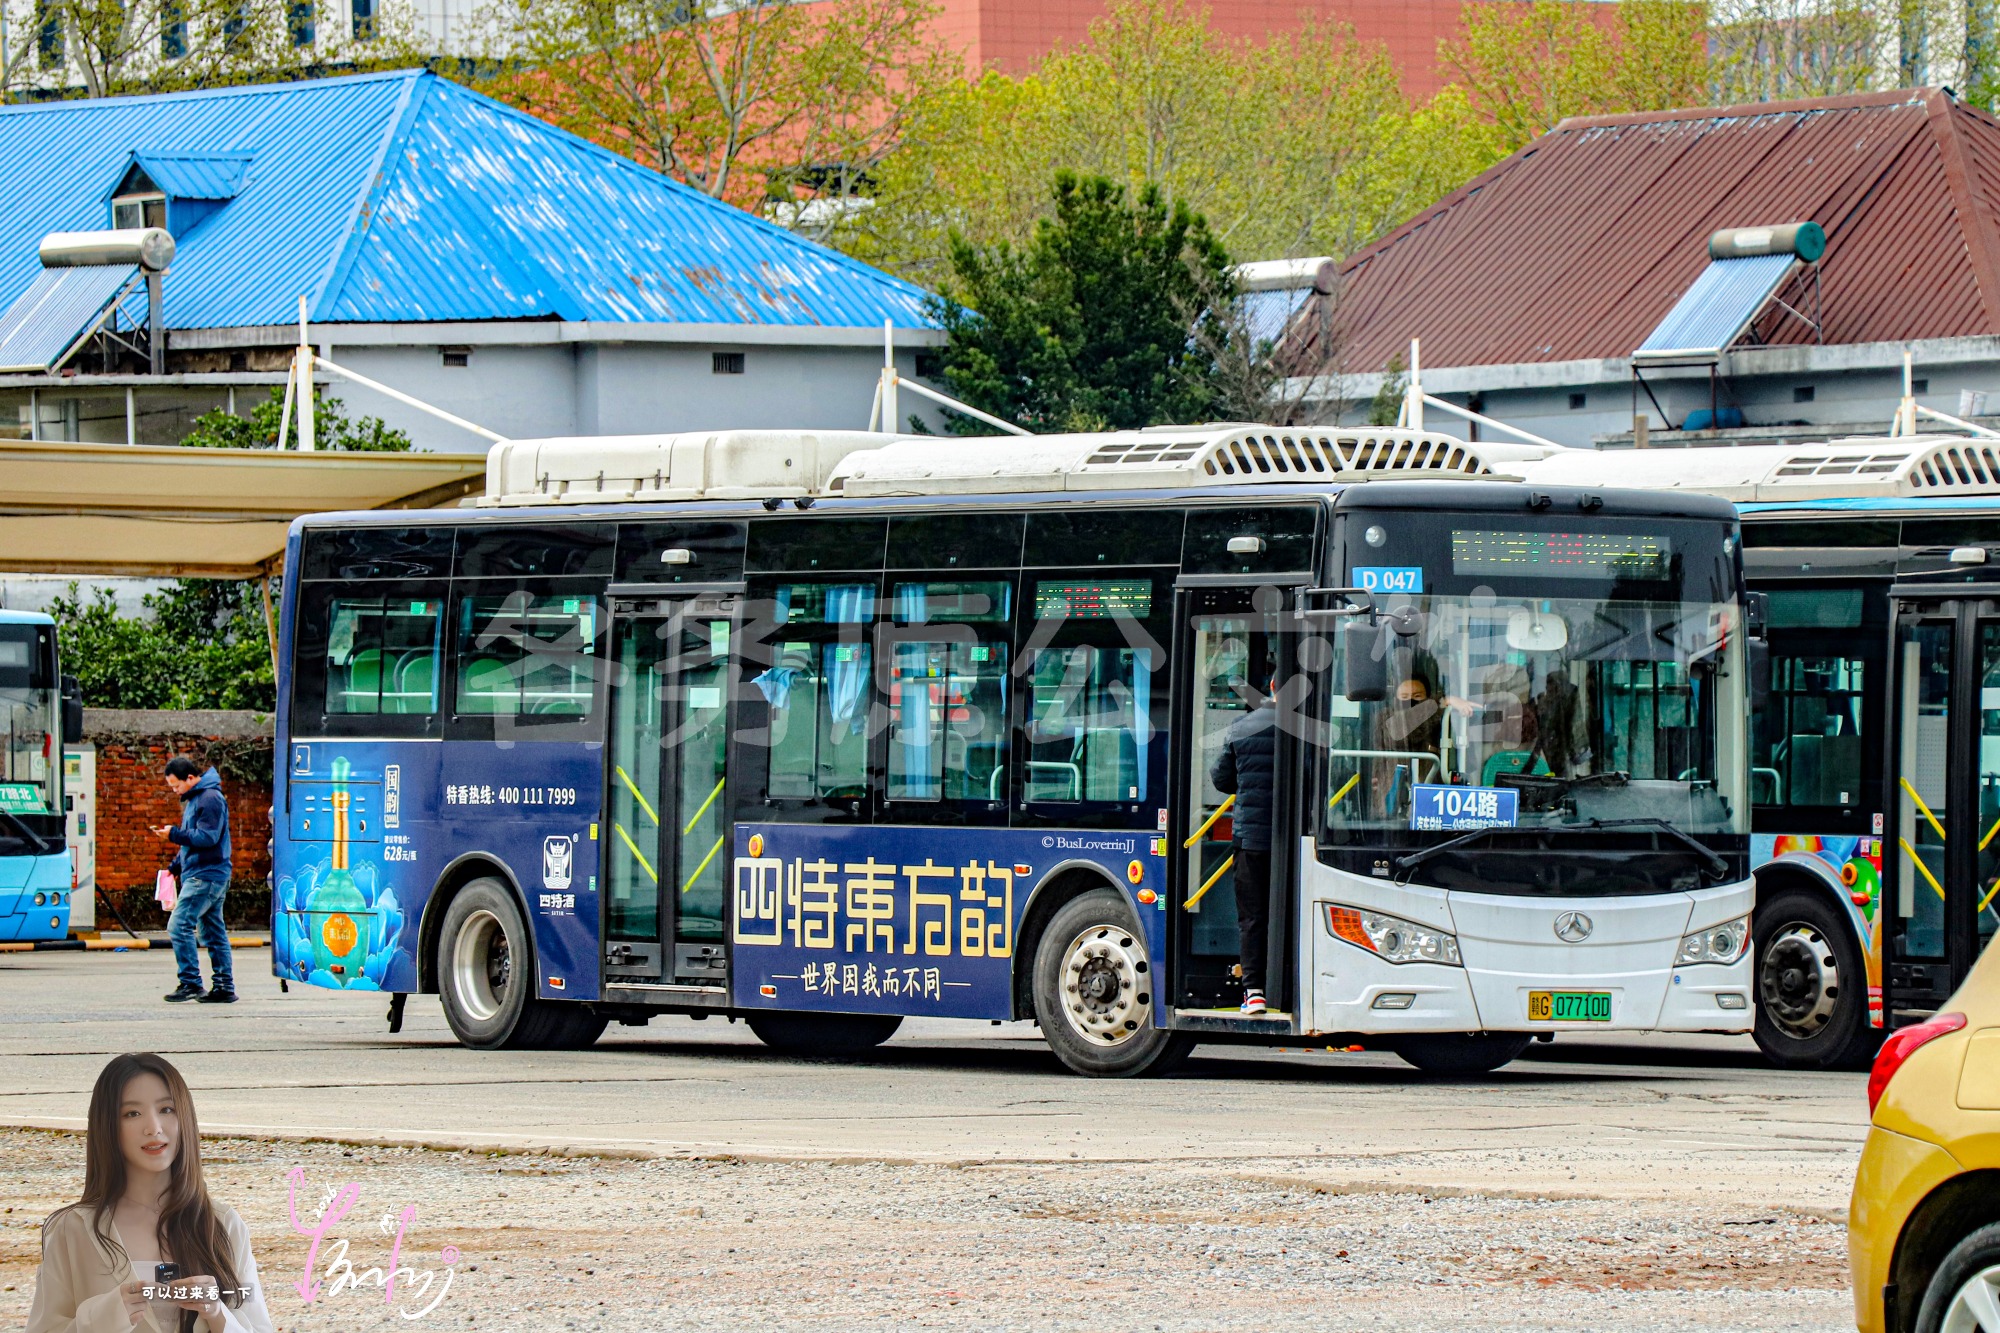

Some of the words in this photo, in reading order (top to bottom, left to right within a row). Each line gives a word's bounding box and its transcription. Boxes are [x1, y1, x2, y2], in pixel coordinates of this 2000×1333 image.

[1362, 570, 1378, 588] D
[1383, 570, 1416, 592] 047
[446, 784, 496, 805] 特香热线:
[498, 787, 520, 804] 400
[523, 787, 544, 804] 111
[547, 787, 576, 805] 7999
[1432, 790, 1498, 818] 104路
[539, 893, 576, 908] 四特酒
[800, 961, 942, 1002] 世界因我而不同
